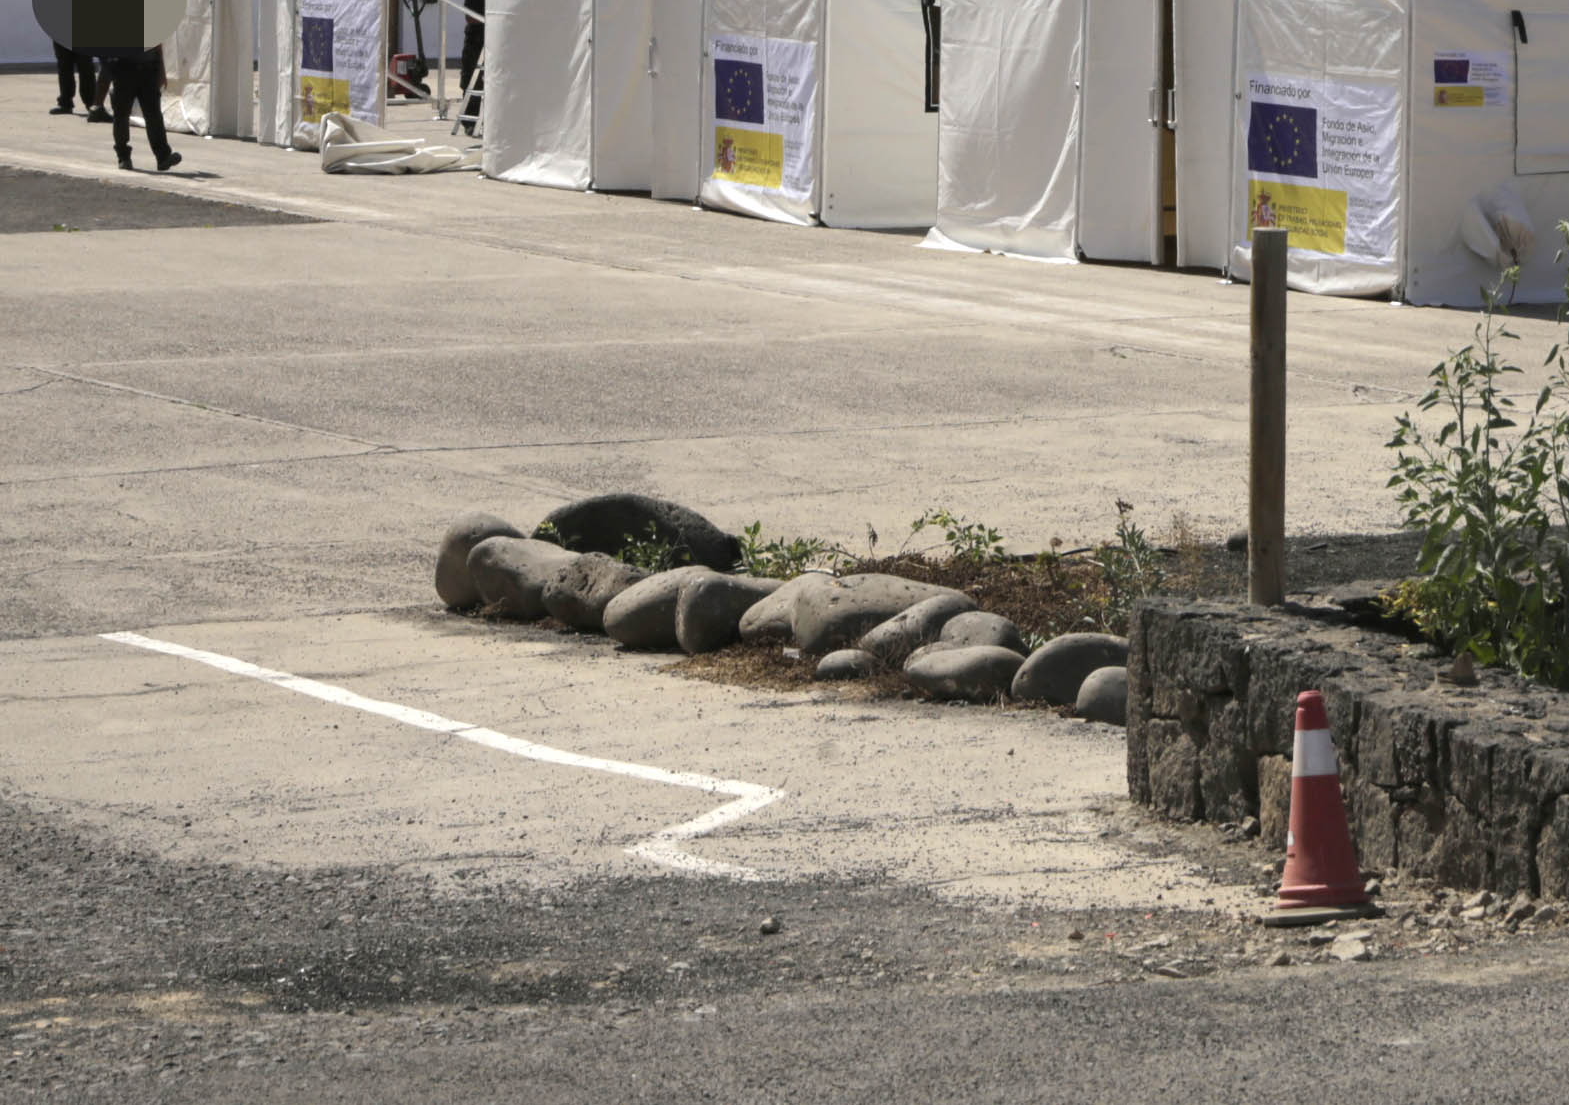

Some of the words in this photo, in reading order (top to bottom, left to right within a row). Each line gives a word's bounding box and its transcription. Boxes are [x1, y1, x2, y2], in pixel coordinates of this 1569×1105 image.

[1249, 79, 1296, 97] Financiado
[1297, 87, 1311, 99] por
[1322, 116, 1344, 131] Fondo
[1346, 120, 1356, 132] de
